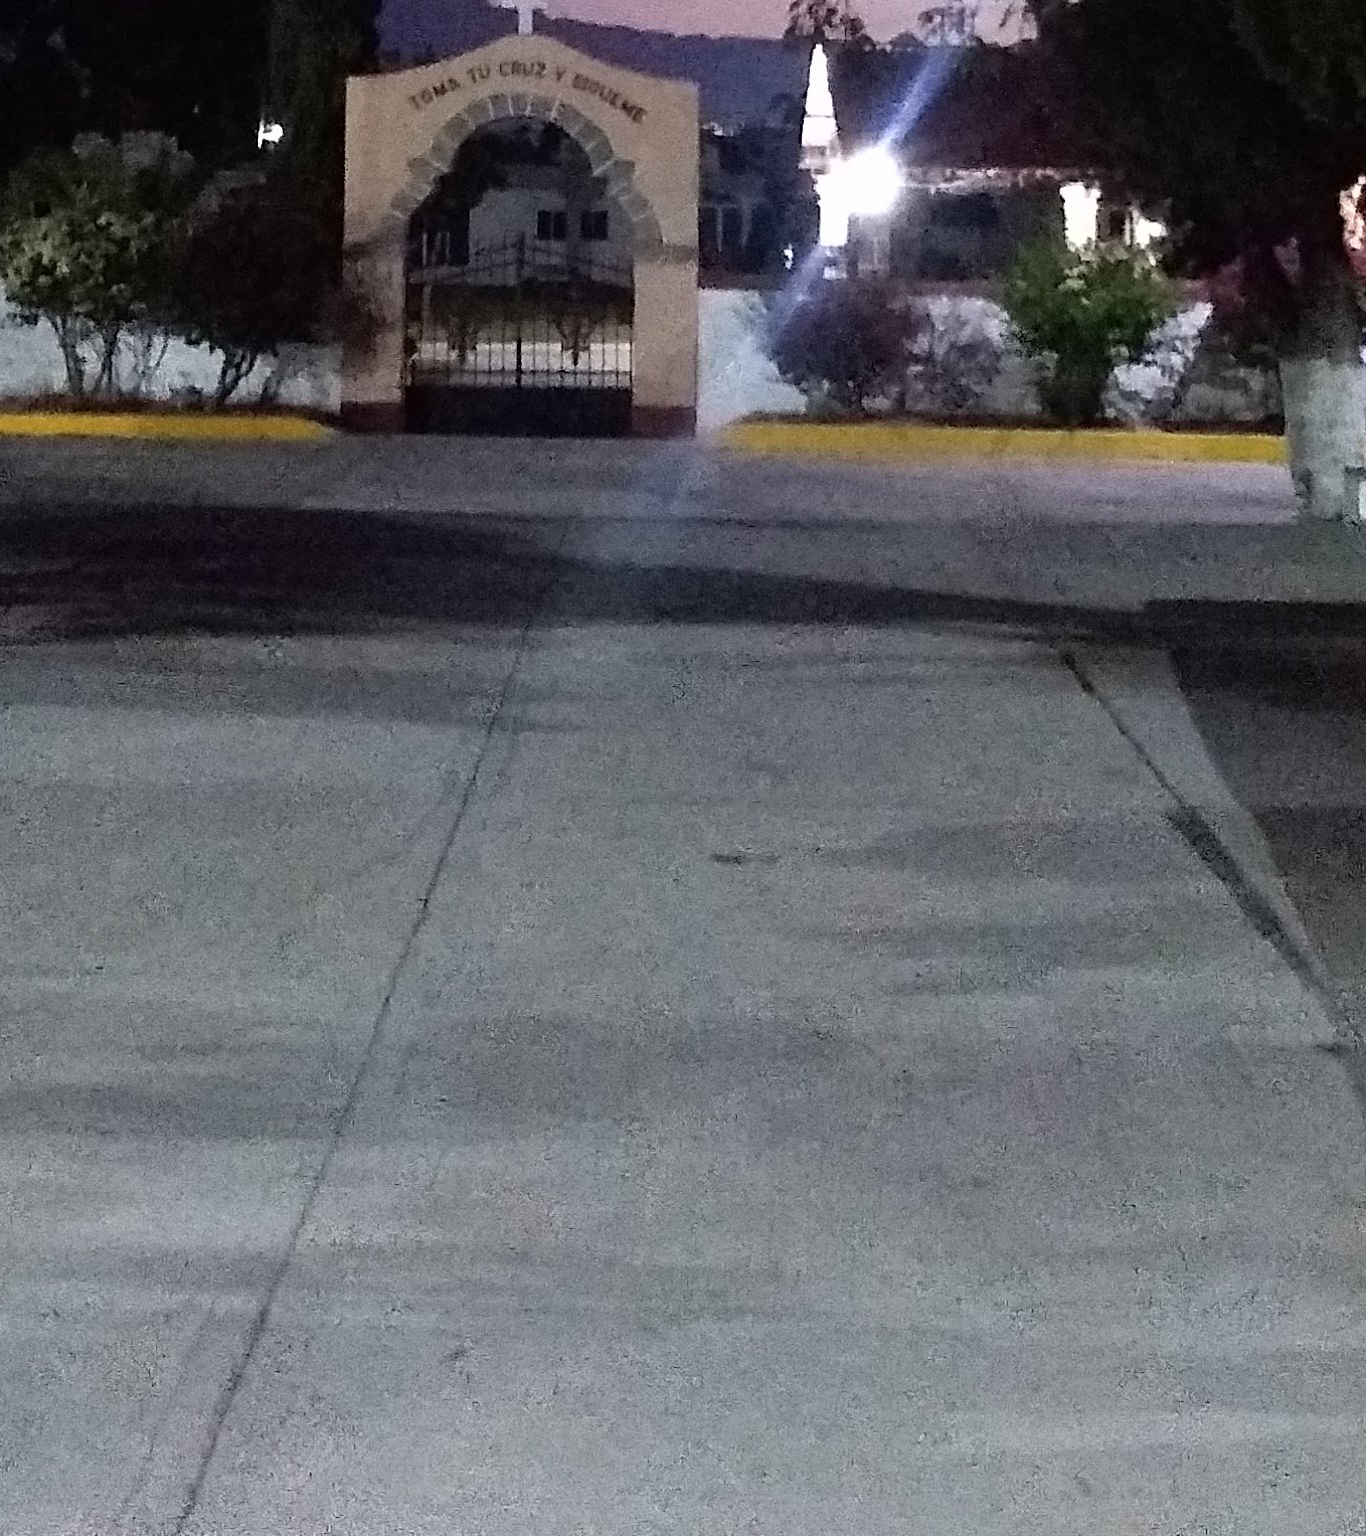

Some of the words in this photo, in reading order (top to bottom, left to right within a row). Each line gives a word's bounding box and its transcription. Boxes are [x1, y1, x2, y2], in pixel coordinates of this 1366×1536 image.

[410, 77, 460, 110] TOMA
[467, 65, 490, 83] TU
[499, 61, 546, 78] CRUZ
[554, 66, 567, 82] Y
